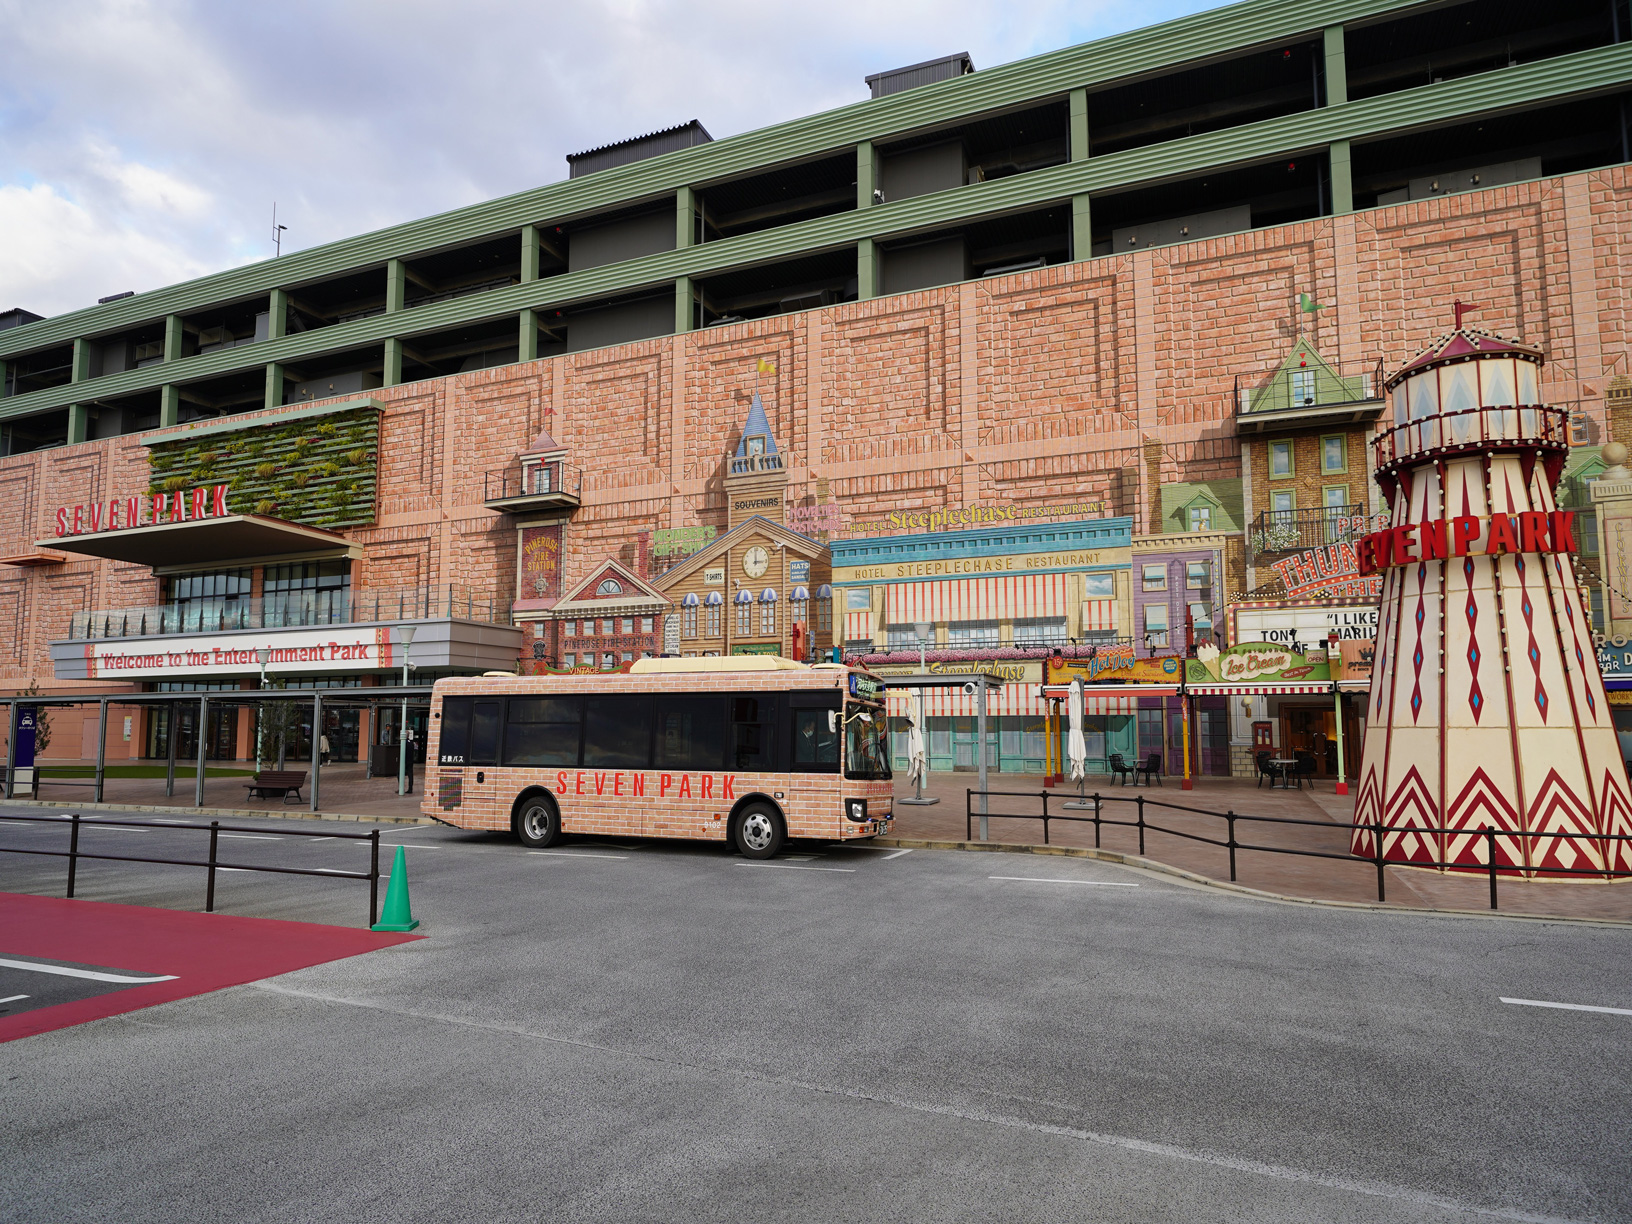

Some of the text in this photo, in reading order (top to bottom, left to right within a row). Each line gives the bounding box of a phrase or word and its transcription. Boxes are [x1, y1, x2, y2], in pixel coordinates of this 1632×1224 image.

[56, 485, 229, 537] SEVEN PARK
[734, 498, 779, 510] SOUVENIRS
[790, 503, 840, 519] NOVELTIES
[850, 501, 1106, 532] HOTEL Steeplechase RESTAURANT
[653, 525, 716, 543] WONDER'S
[1453, 511, 1577, 556] PARK
[524, 536, 558, 554] PINEROSE
[654, 540, 714, 556] GIFT SHO
[534, 551, 549, 561] FIRE
[527, 560, 555, 571] STATION
[855, 553, 1101, 579] HOTEL STEEPLECHASE RESTAURANT
[1344, 612, 1376, 625] LIKE
[564, 636, 655, 650] PINEROSE FIRE STATION
[101, 641, 369, 669] Welcome to the Enterinment Park
[1088, 654, 1136, 679] Hot Dog
[1226, 659, 1245, 676] Ice
[1246, 655, 1286, 672] Cream
[556, 770, 736, 799] SEVEN PARK
[704, 821, 721, 829] 9102
